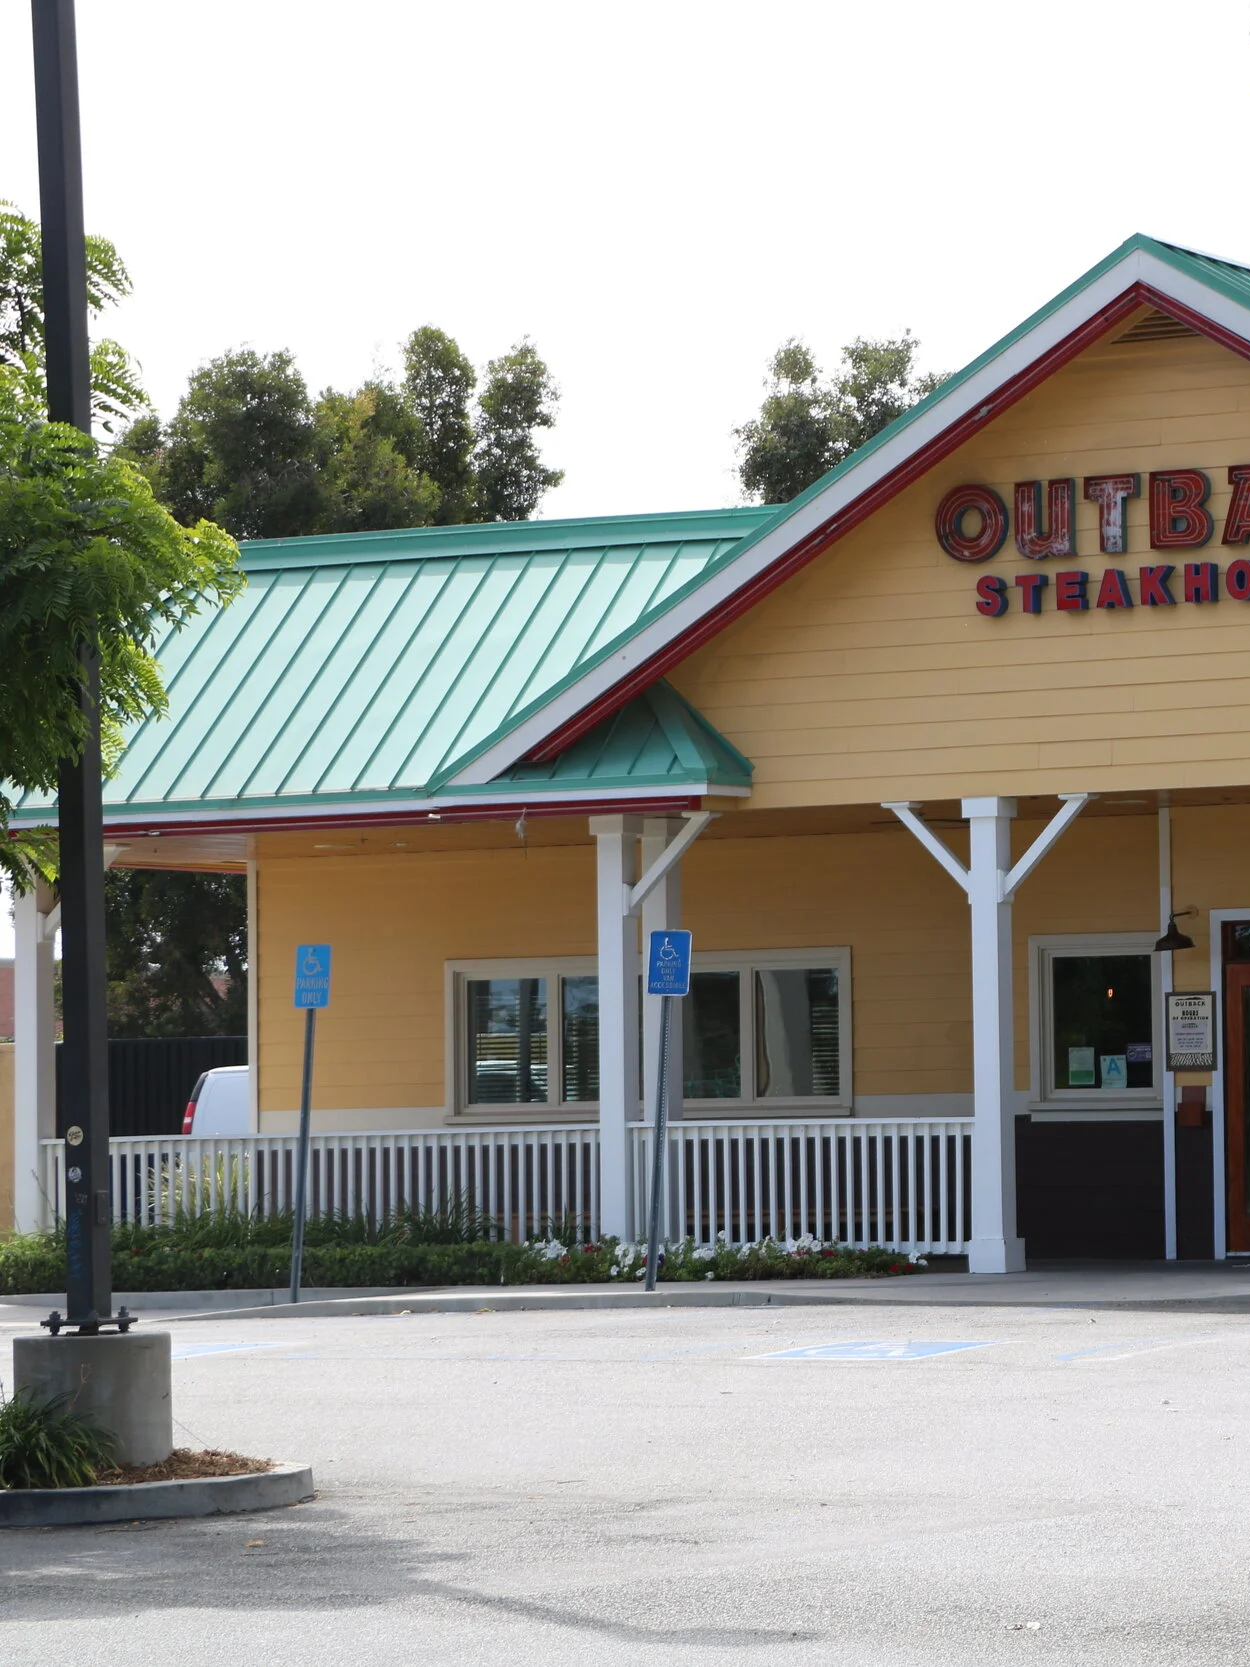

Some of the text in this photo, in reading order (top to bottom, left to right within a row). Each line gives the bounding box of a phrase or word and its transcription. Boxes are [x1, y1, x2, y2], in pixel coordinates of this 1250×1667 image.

[656, 960, 681, 968] PARKING
[296, 977, 329, 989] PARKING
[302, 991, 321, 1004] ONLY
[1107, 1058, 1121, 1075] A
